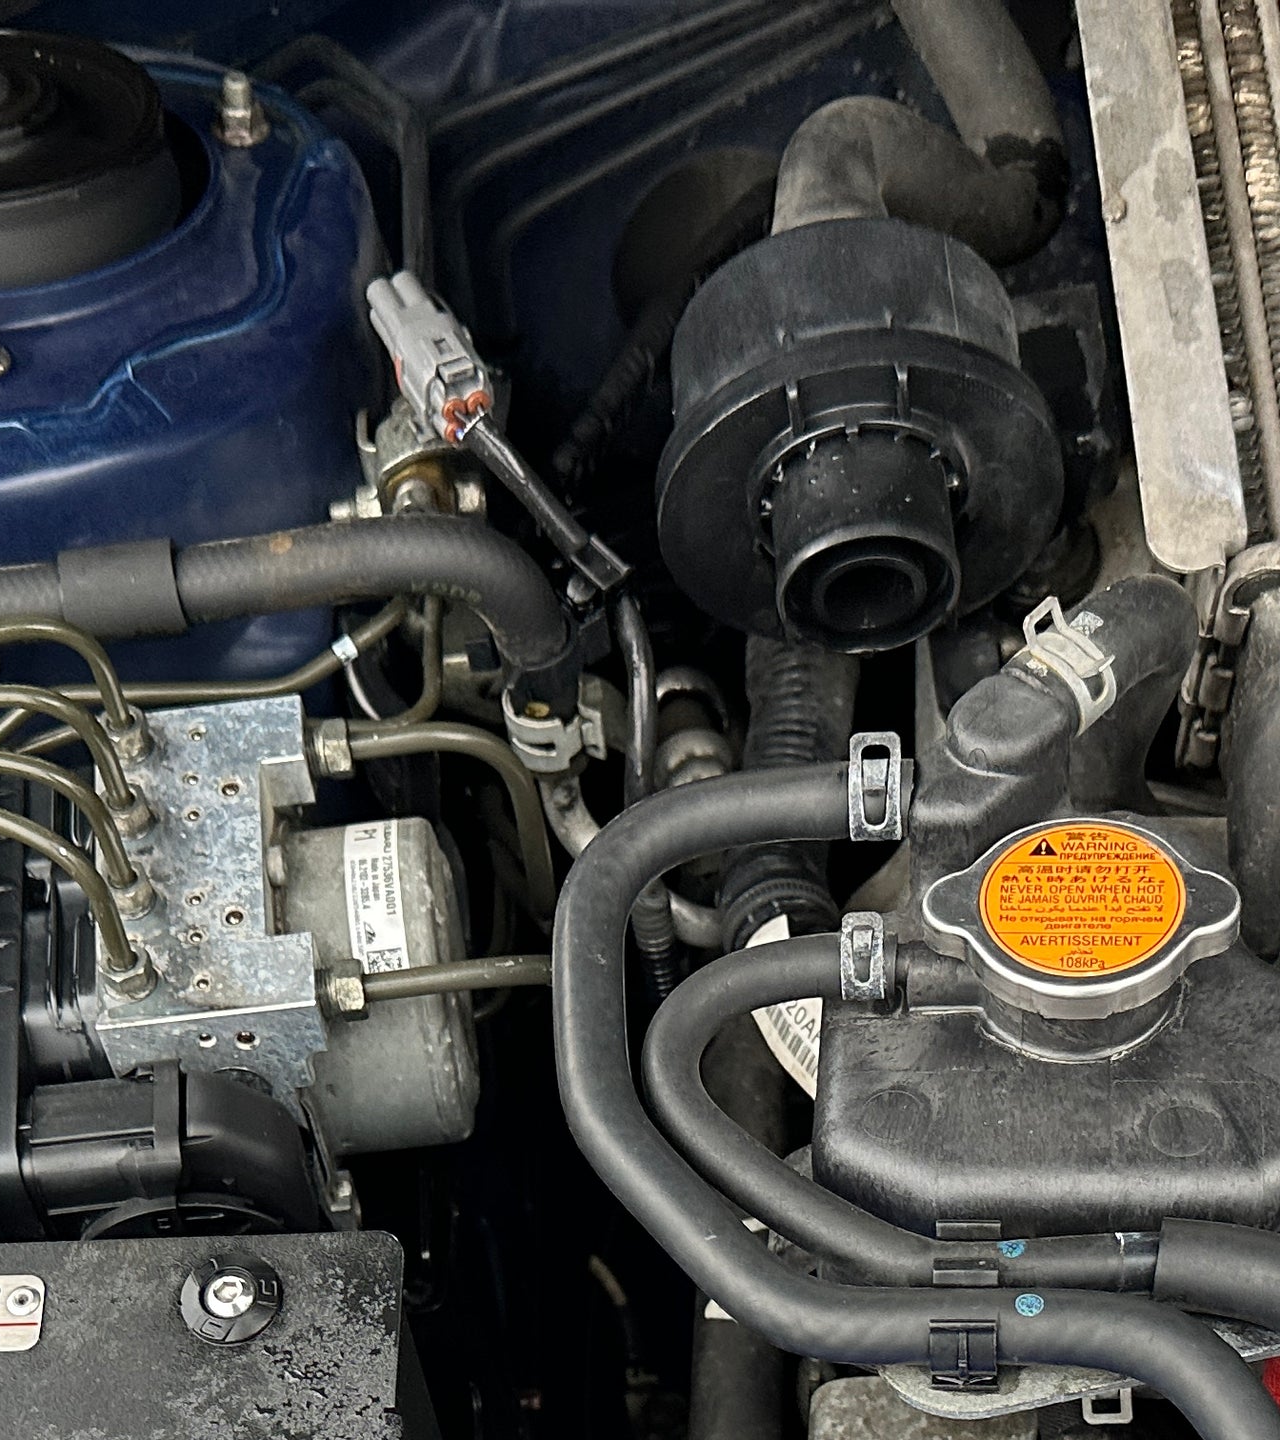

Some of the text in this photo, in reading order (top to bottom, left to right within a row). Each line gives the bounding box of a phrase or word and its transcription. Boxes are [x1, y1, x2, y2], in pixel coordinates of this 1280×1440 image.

[1065, 832, 1108, 841] 警告
[1061, 842, 1137, 851] WARNING
[1059, 852, 1156, 861] ПРЕДУПРЕЖДЕНИЕ
[1018, 865, 1151, 874] 高温时请勿打开
[1001, 875, 1165, 884] 熱い時あけるな。
[382, 855, 397, 917] 27536VA001
[1000, 885, 1042, 894] NEVER
[1049, 885, 1085, 894] OPEN
[1089, 885, 1131, 894] WHEN
[1000, 895, 1013, 904] NE
[1018, 895, 1060, 904] JAMAIS
[1064, 895, 1107, 904] OUVRIR
[1020, 915, 1088, 924] открывать
[1110, 916, 1164, 924] горячем
[1020, 935, 1142, 946] AVERTISSEMENT
[1058, 957, 1105, 969] 108kPa
